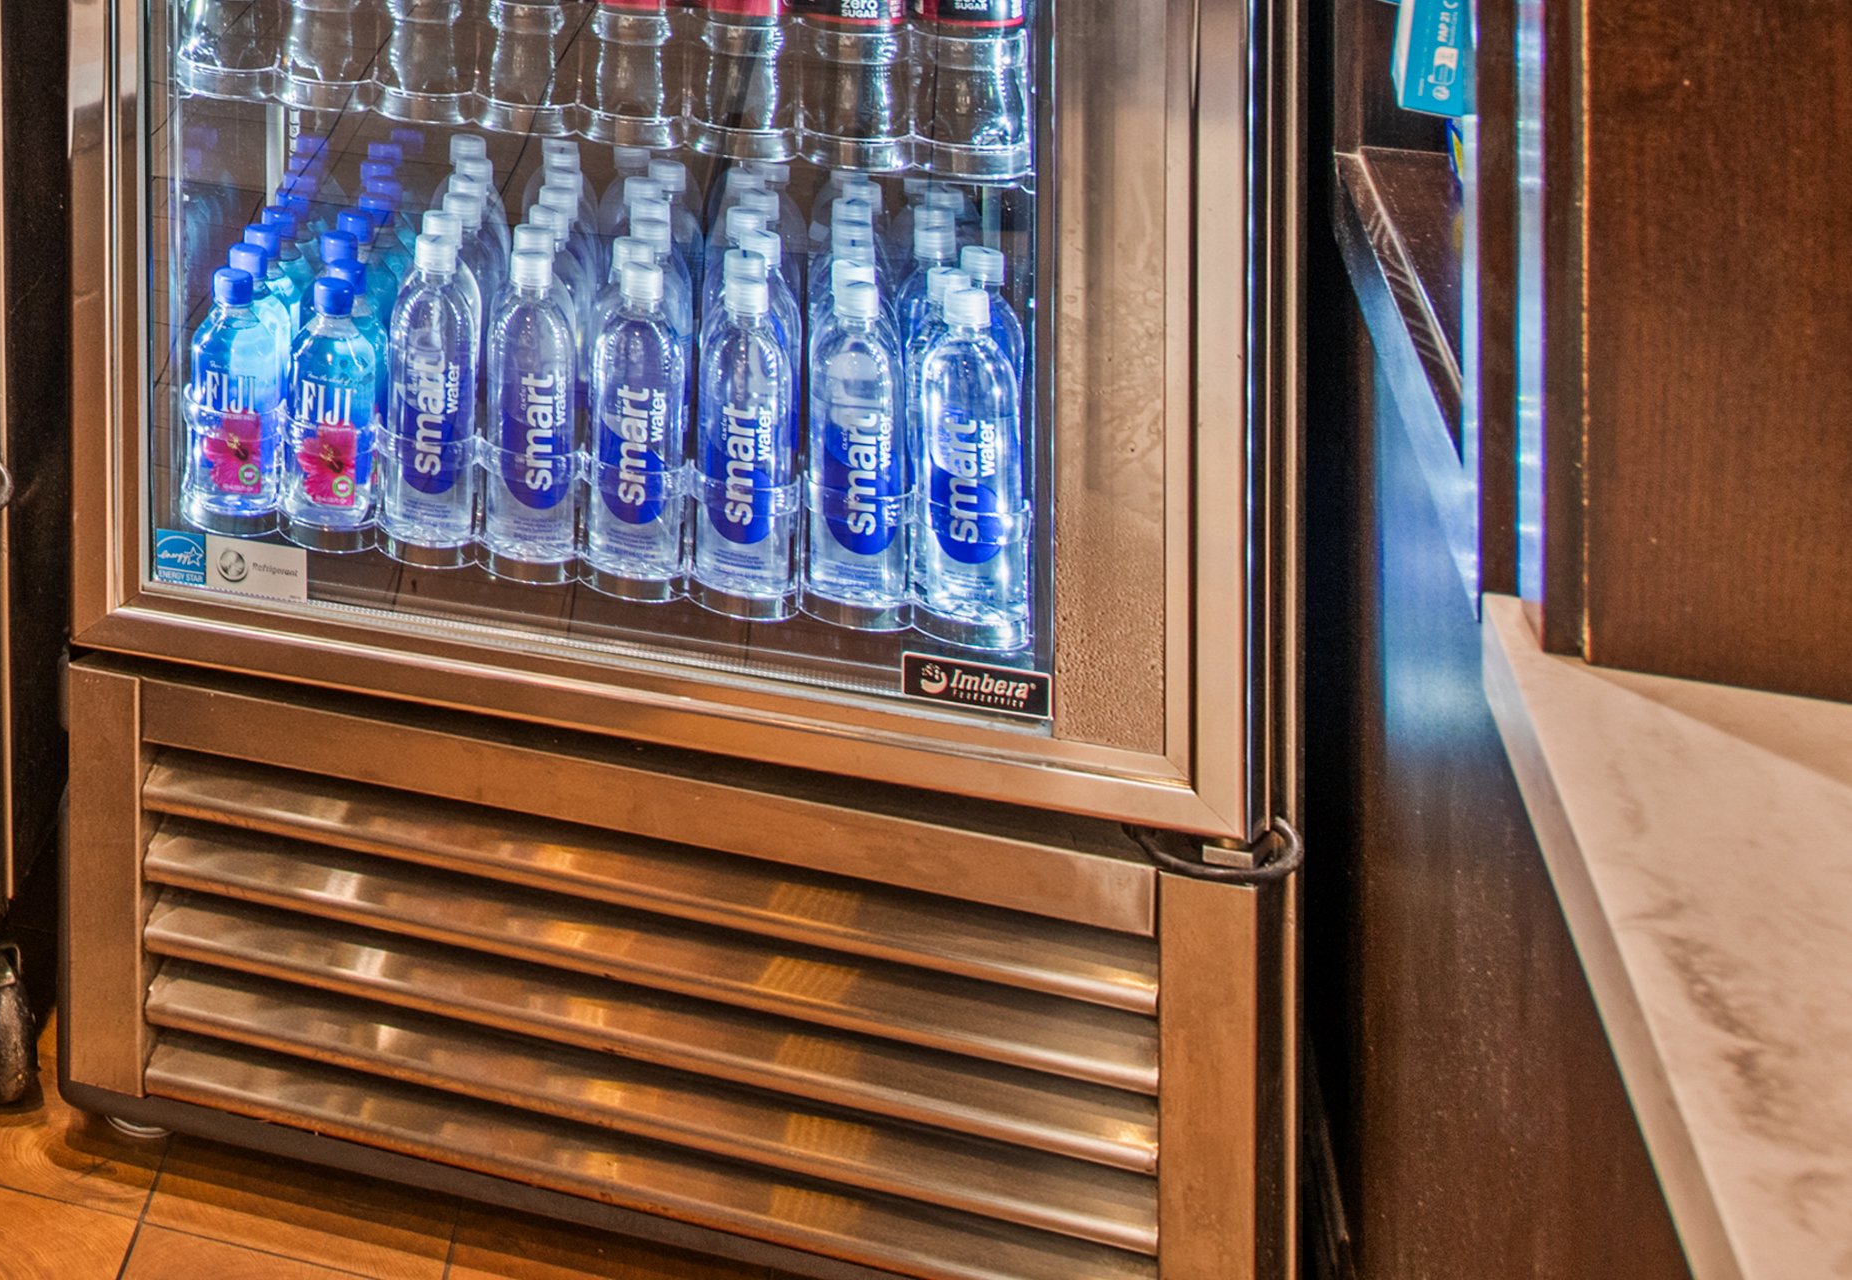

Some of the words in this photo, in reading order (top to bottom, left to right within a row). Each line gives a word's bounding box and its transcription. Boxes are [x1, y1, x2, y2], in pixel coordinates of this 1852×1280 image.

[841, 8, 878, 19] SUGAR
[954, 2, 988, 11] SUGAR
[1440, 7, 1451, 20] 21
[1437, 19, 1449, 42] PAP
[206, 370, 256, 415] FIJI
[300, 380, 352, 427] FIJI
[446, 361, 460, 416] water
[555, 374, 568, 427] water
[414, 350, 447, 476] smart
[526, 373, 553, 492] smart
[252, 562, 299, 578] Refrigerant
[950, 668, 1030, 700] Imbera
